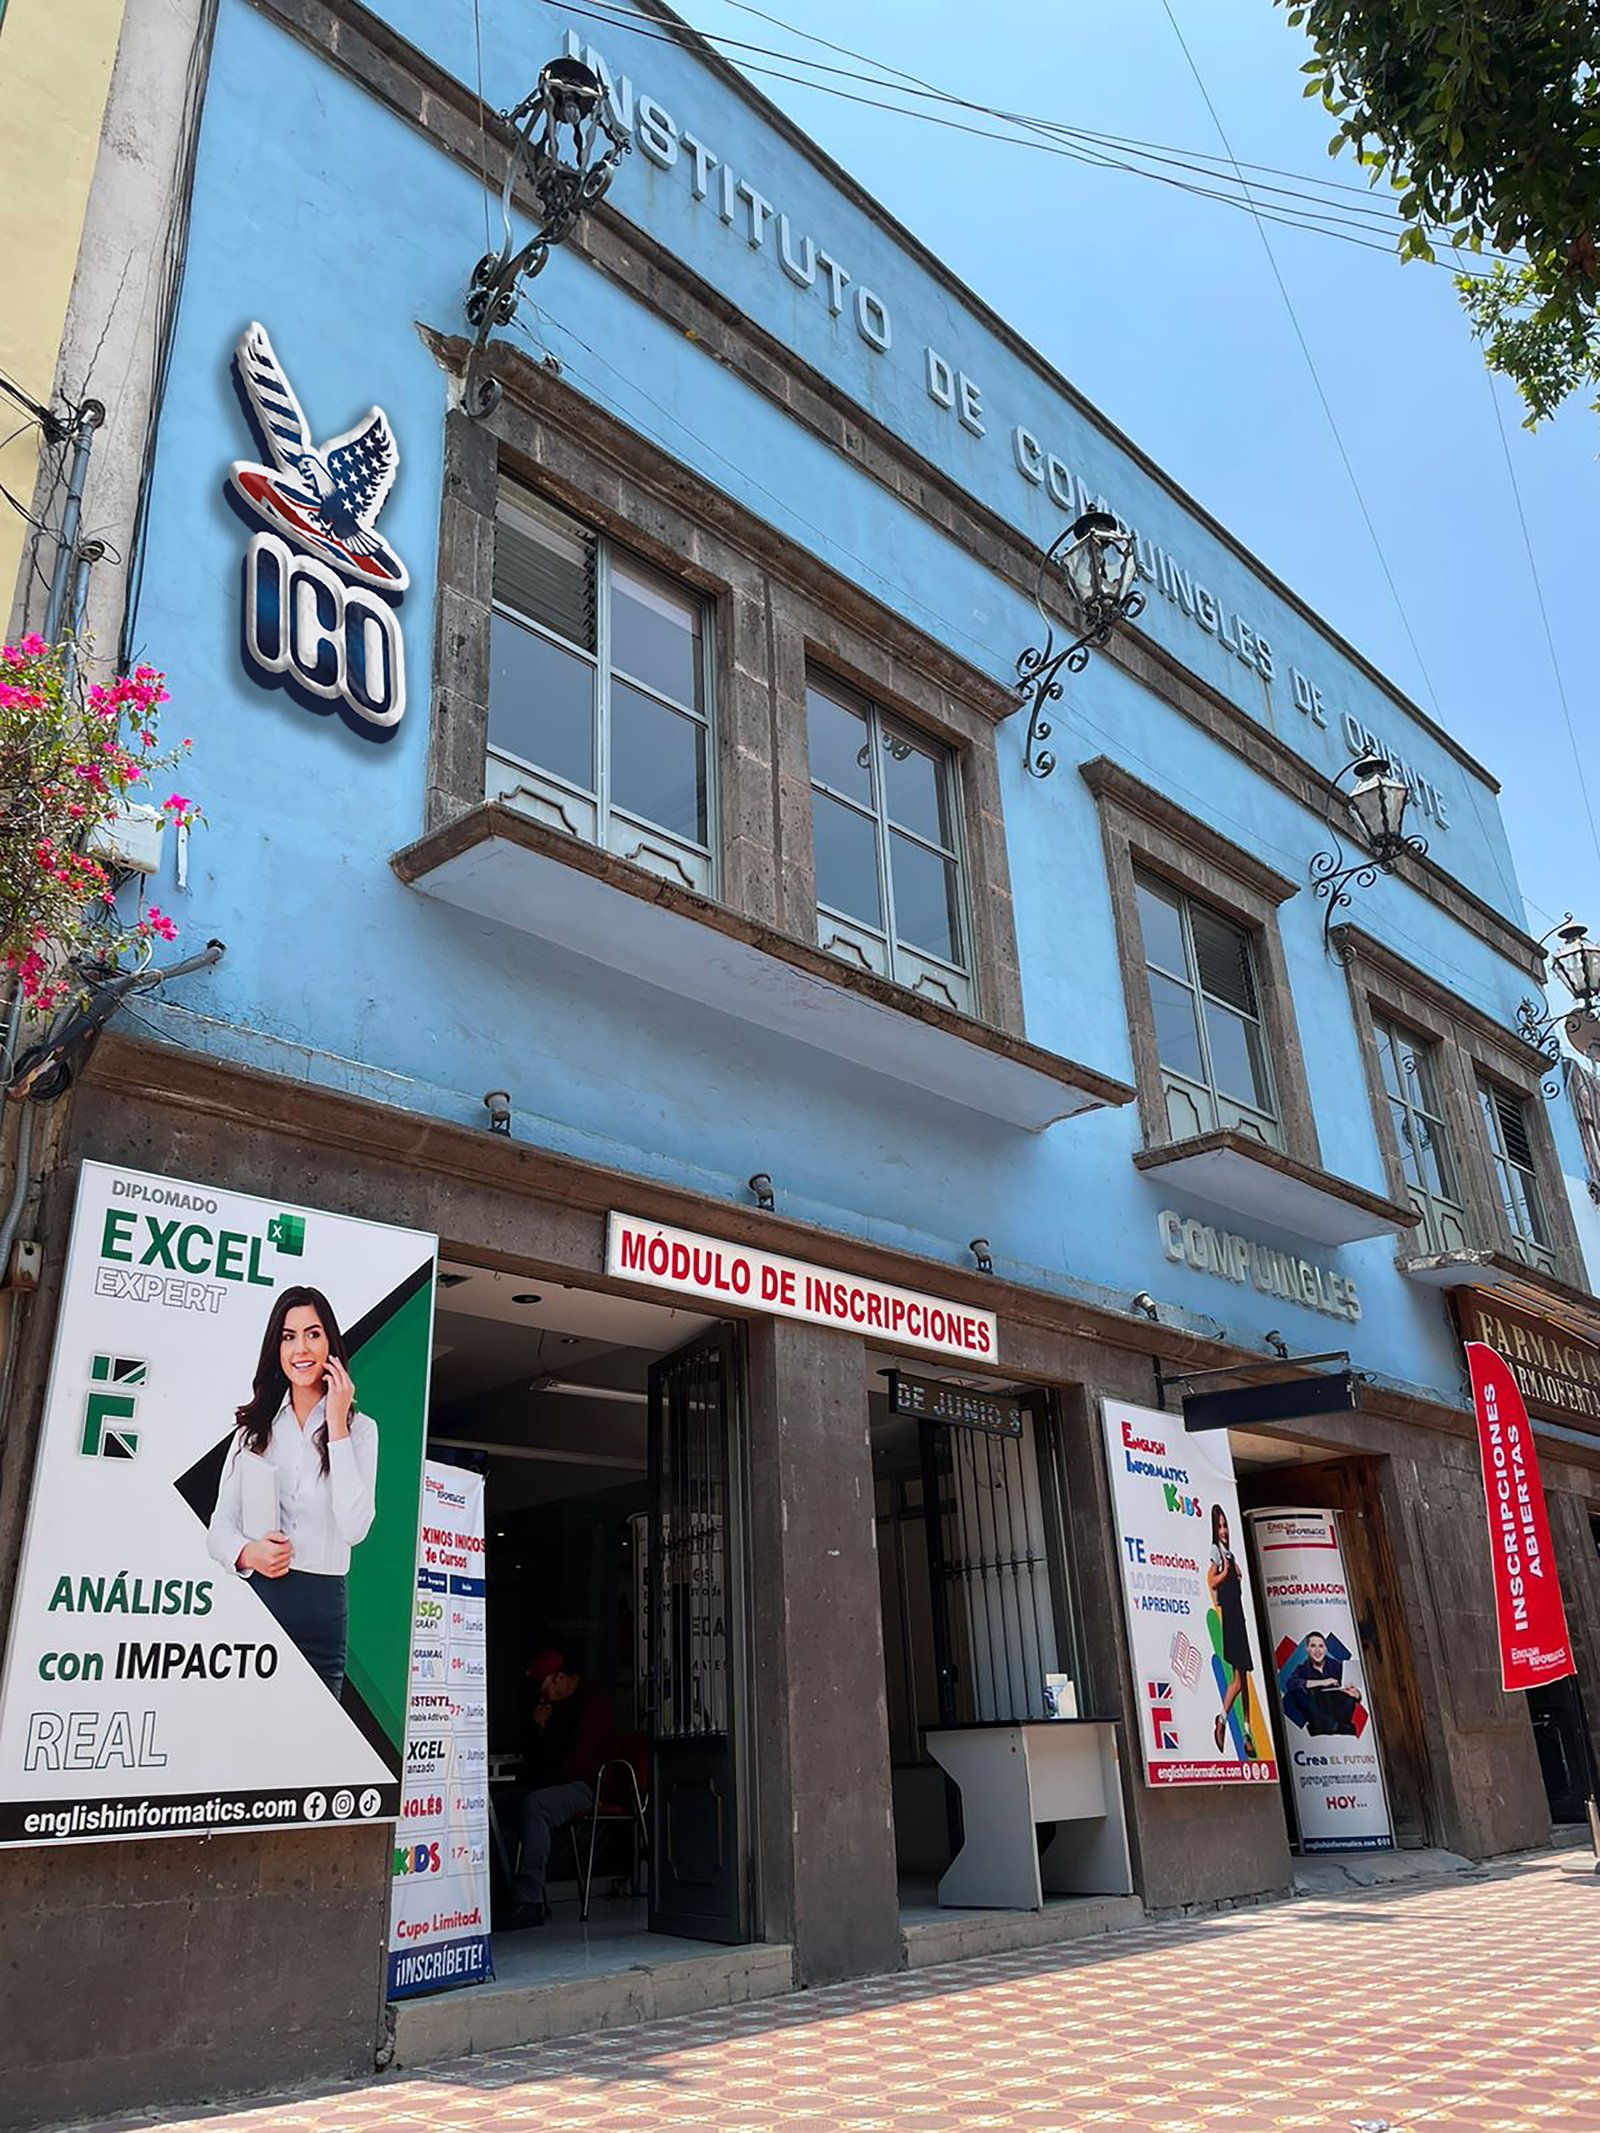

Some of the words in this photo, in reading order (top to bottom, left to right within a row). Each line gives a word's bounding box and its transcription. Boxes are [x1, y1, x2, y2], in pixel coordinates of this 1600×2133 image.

[563, 28, 891, 354] INSTITUTO
[924, 345, 986, 439] DE
[1289, 665, 1327, 730] DE
[112, 1180, 218, 1214] DIPLOMADO
[101, 1208, 274, 1287] EXCEL
[1157, 1210, 1362, 1322] COMPUINGLES
[95, 1266, 227, 1314] EXPERT
[620, 1230, 751, 1295] MÓDULO
[761, 1265, 796, 1307] DE
[805, 1276, 990, 1353] INSCRIPCIONES
[1484, 1382, 1528, 1631] INSCRIPCIONES
[1508, 1424, 1544, 1579] ABIERTAS
[439, 1550, 467, 1569] Cursos
[1124, 1536, 1146, 1563] TE
[48, 1570, 214, 1616] ANÁLISIS
[1142, 1595, 1190, 1615] APRENDES
[38, 1651, 104, 1681] con
[115, 1642, 278, 1680] IMPACTO
[24, 1711, 168, 1771] REAL
[1294, 1751, 1328, 1766] Crea
[24, 1797, 297, 1836] englishinformatics.com
[396, 1918, 429, 1940] Cupo
[395, 1944, 484, 1987] ¡INSCRÍBETE!
